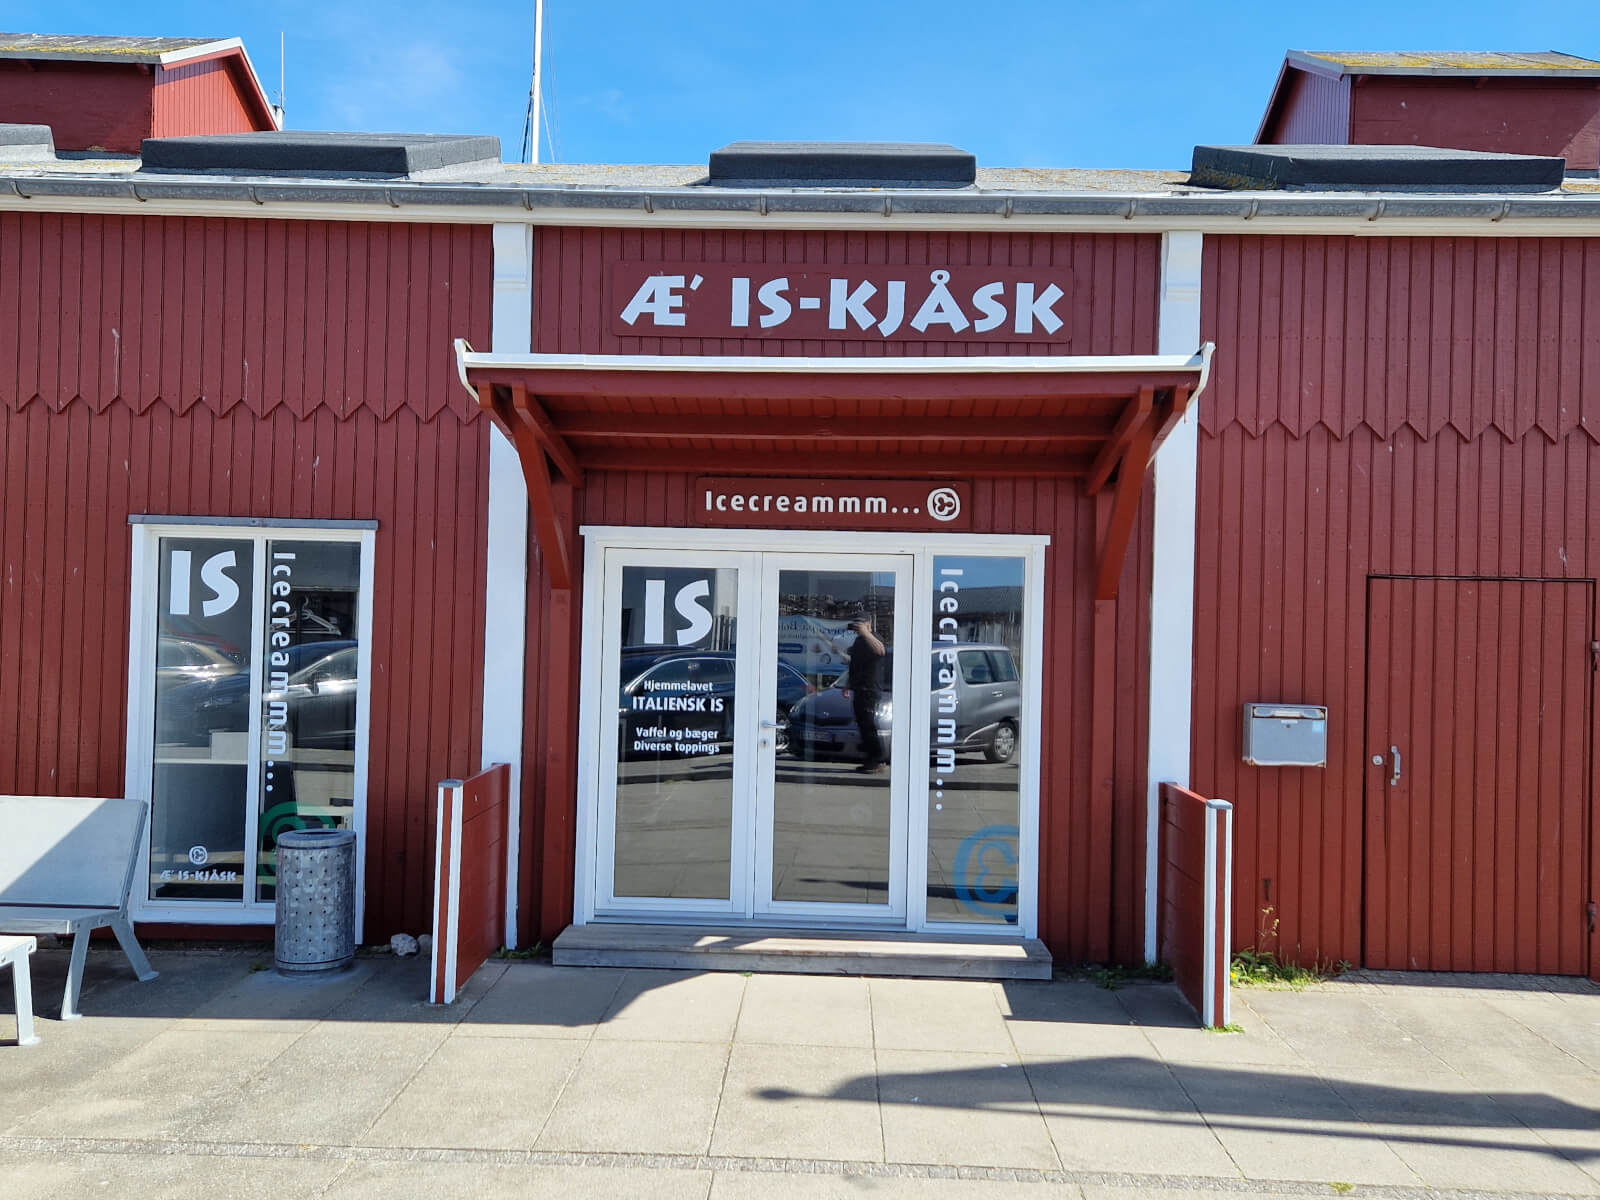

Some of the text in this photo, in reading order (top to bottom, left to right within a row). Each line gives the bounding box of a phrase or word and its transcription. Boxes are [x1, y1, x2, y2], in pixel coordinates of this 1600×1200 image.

[731, 270, 1064, 337] IS-KJÅSK
[706, 490, 919, 514] Icecreammm...
[170, 551, 239, 617] IS
[644, 579, 713, 646] IS
[643, 680, 713, 693] Hjemmelavet
[632, 696, 724, 712] ITALIENSK IS
[636, 727, 719, 741] Vaffel og bæger
[634, 741, 720, 755] Diverse toppings
[178, 869, 236, 882] IS-KJÅSK
